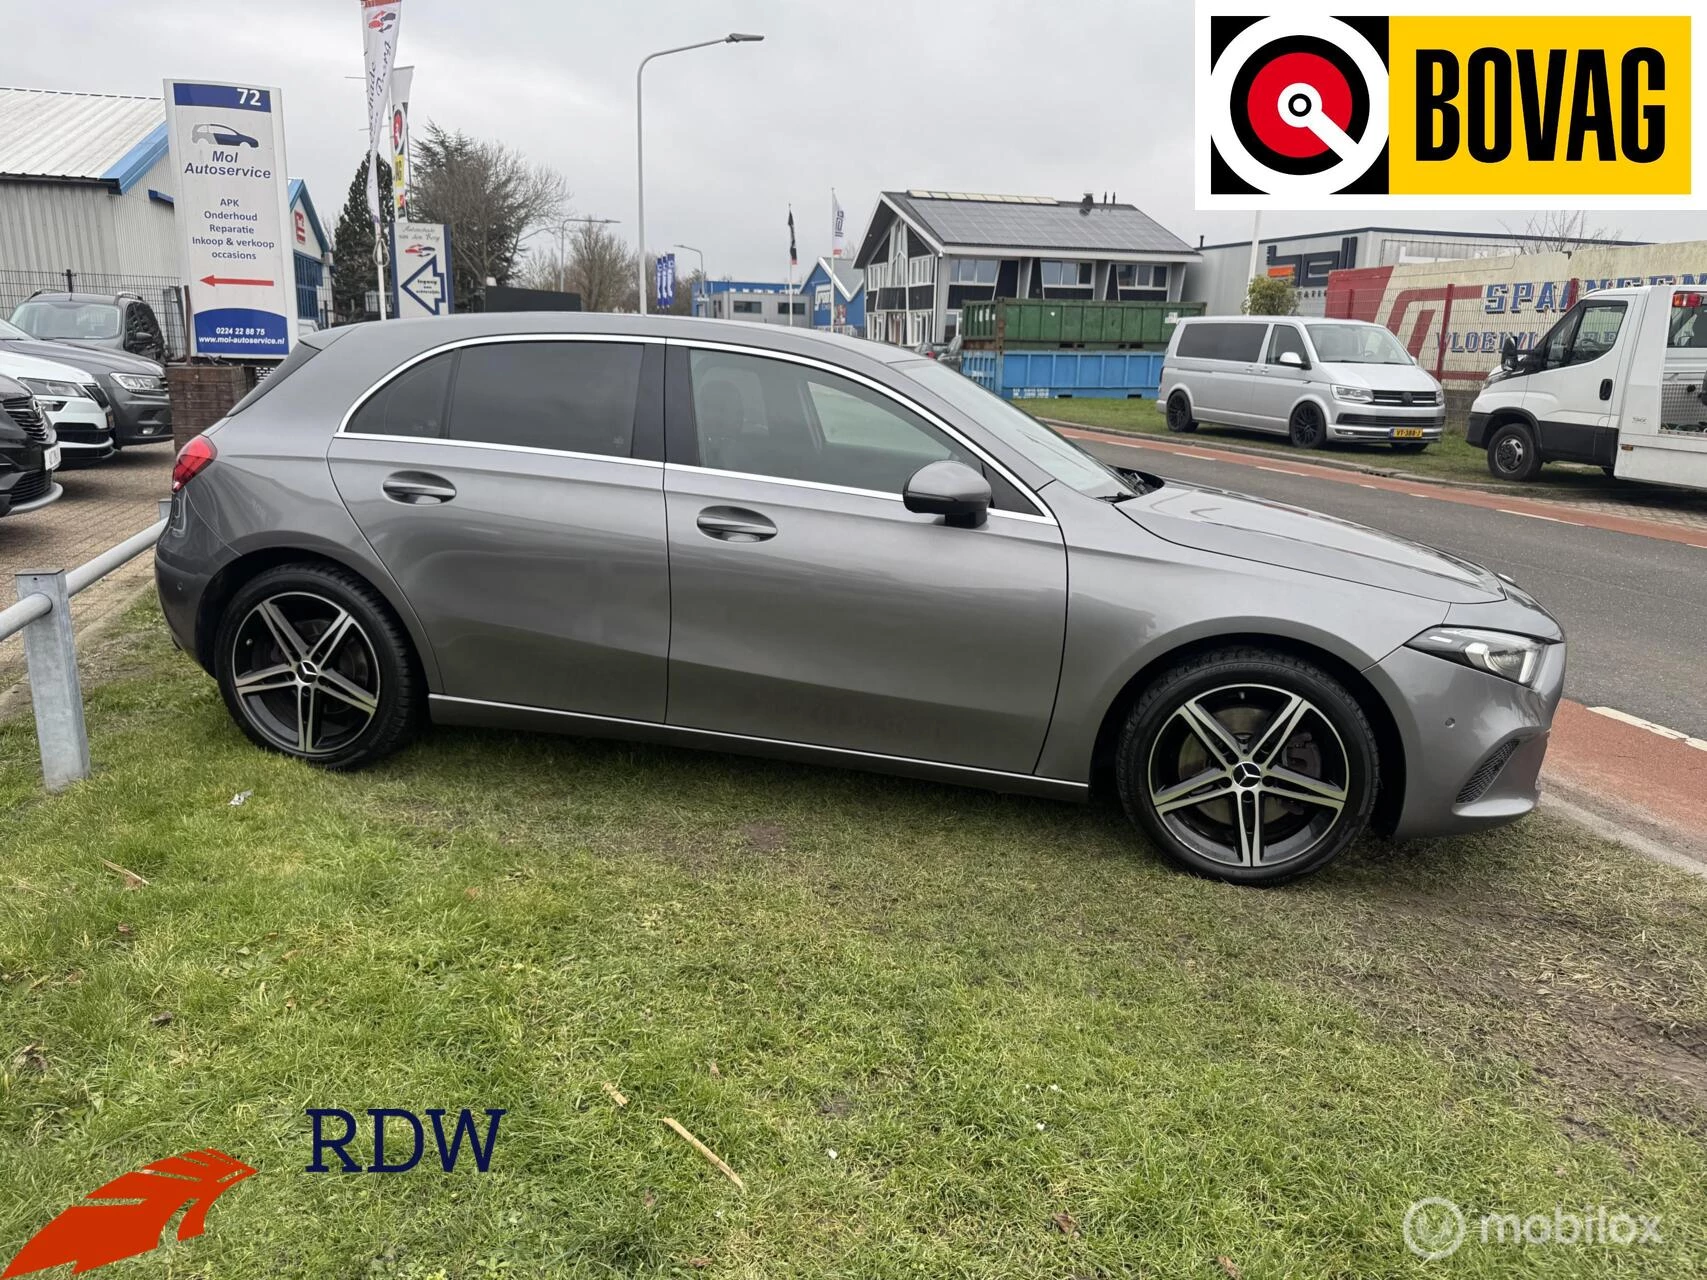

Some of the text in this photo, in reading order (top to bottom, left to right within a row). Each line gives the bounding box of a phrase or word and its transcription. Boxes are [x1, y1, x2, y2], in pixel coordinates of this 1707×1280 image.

[237, 88, 262, 106] 72
[212, 150, 239, 163] Mol
[184, 162, 271, 178] Autoservice
[220, 198, 240, 207] APK
[204, 210, 258, 221] Onderhoud
[209, 224, 255, 234] Reparatie
[192, 236, 275, 250] Inkoop & verkoop
[211, 250, 257, 260] occasions
[215, 327, 266, 336] 0224 22 88 75
[199, 336, 285, 345] www.mol-autoservice.nl
